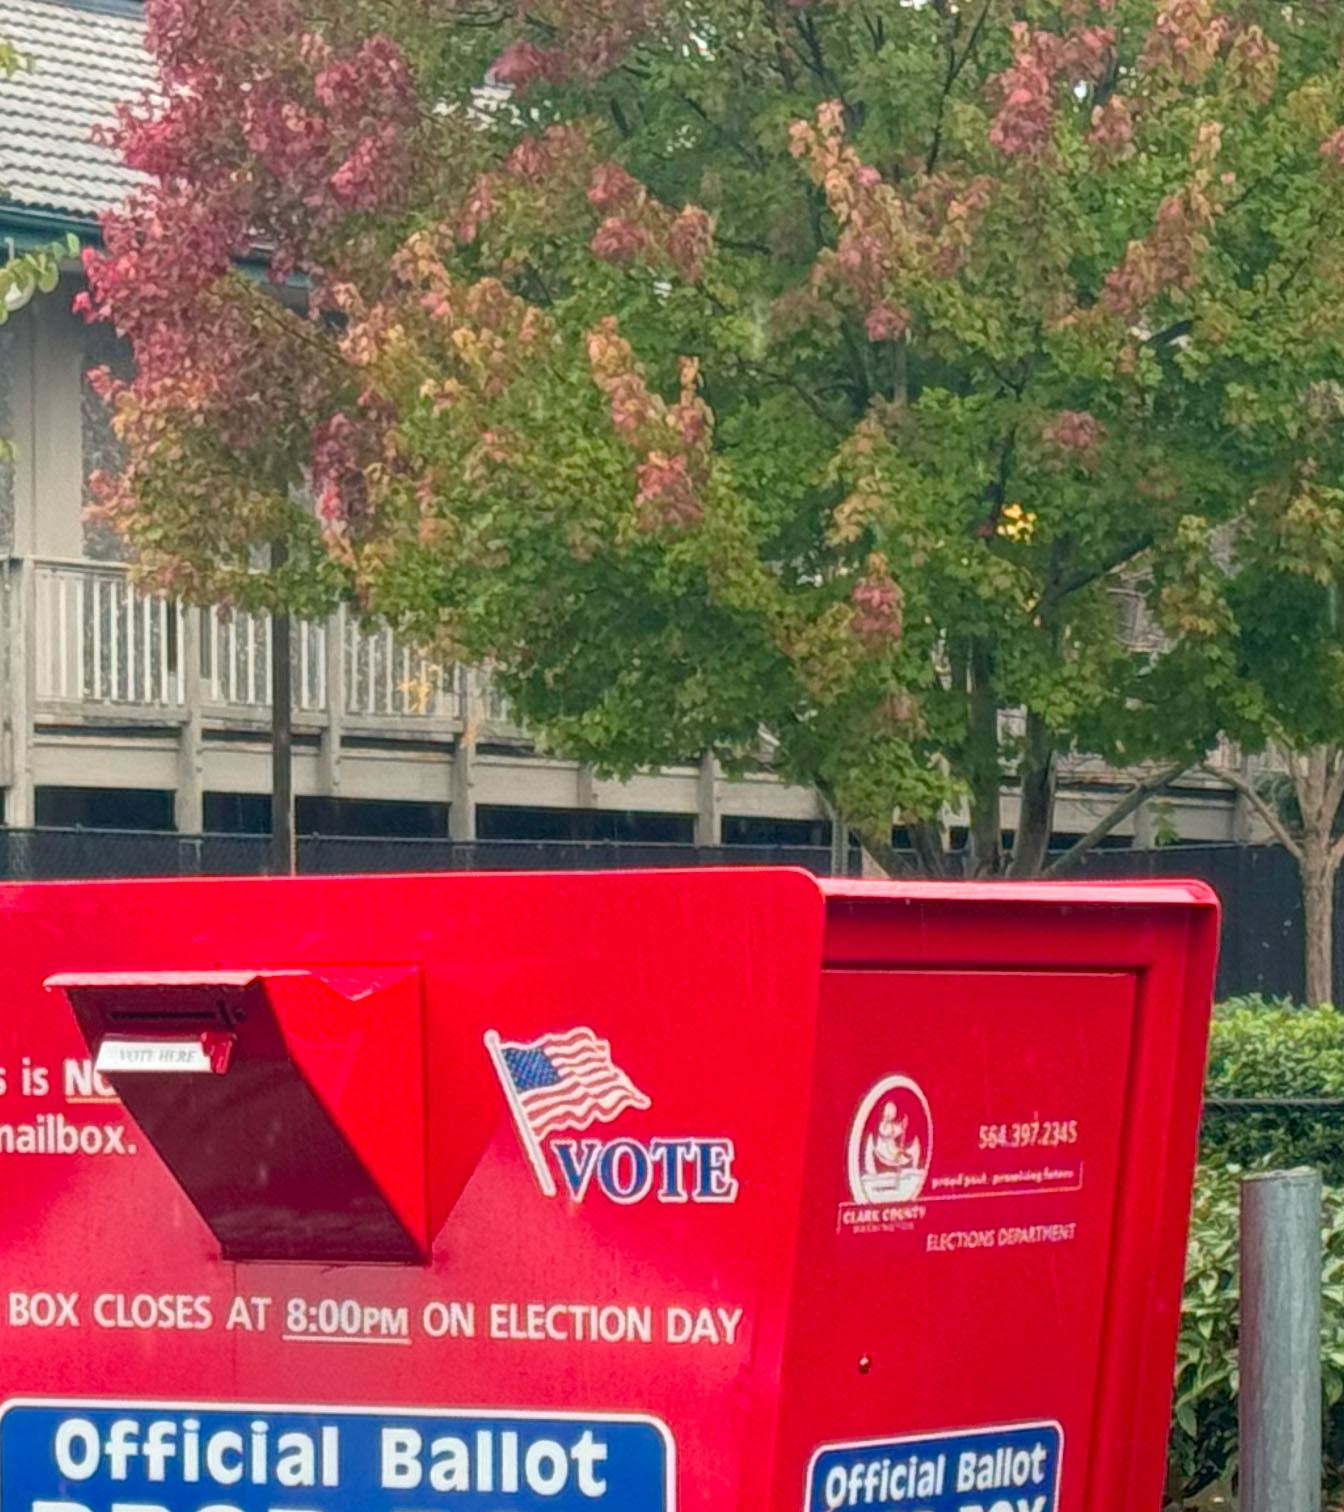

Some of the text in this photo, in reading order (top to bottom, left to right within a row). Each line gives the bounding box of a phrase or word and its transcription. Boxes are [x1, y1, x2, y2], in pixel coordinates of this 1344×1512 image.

[120, 1049, 197, 1063] VOTE HERE
[23, 1059, 49, 1096] is
[979, 1119, 1078, 1149] 564.397.2345
[549, 1137, 738, 1204] VOTE
[843, 1209, 879, 1225] CLARK
[926, 1223, 1076, 1252] ELECTIONS DEPARTMENT
[9, 1293, 79, 1327] BOX
[94, 1294, 212, 1329] CLOSES
[226, 1297, 272, 1330] AT
[286, 1297, 408, 1335] 8:00PM
[423, 1302, 474, 1337] ON
[490, 1303, 652, 1342] ELECTION
[666, 1307, 743, 1344] DAY
[55, 1417, 609, 1497] Official Ballot
[825, 1442, 1046, 1509] Official Ballot
